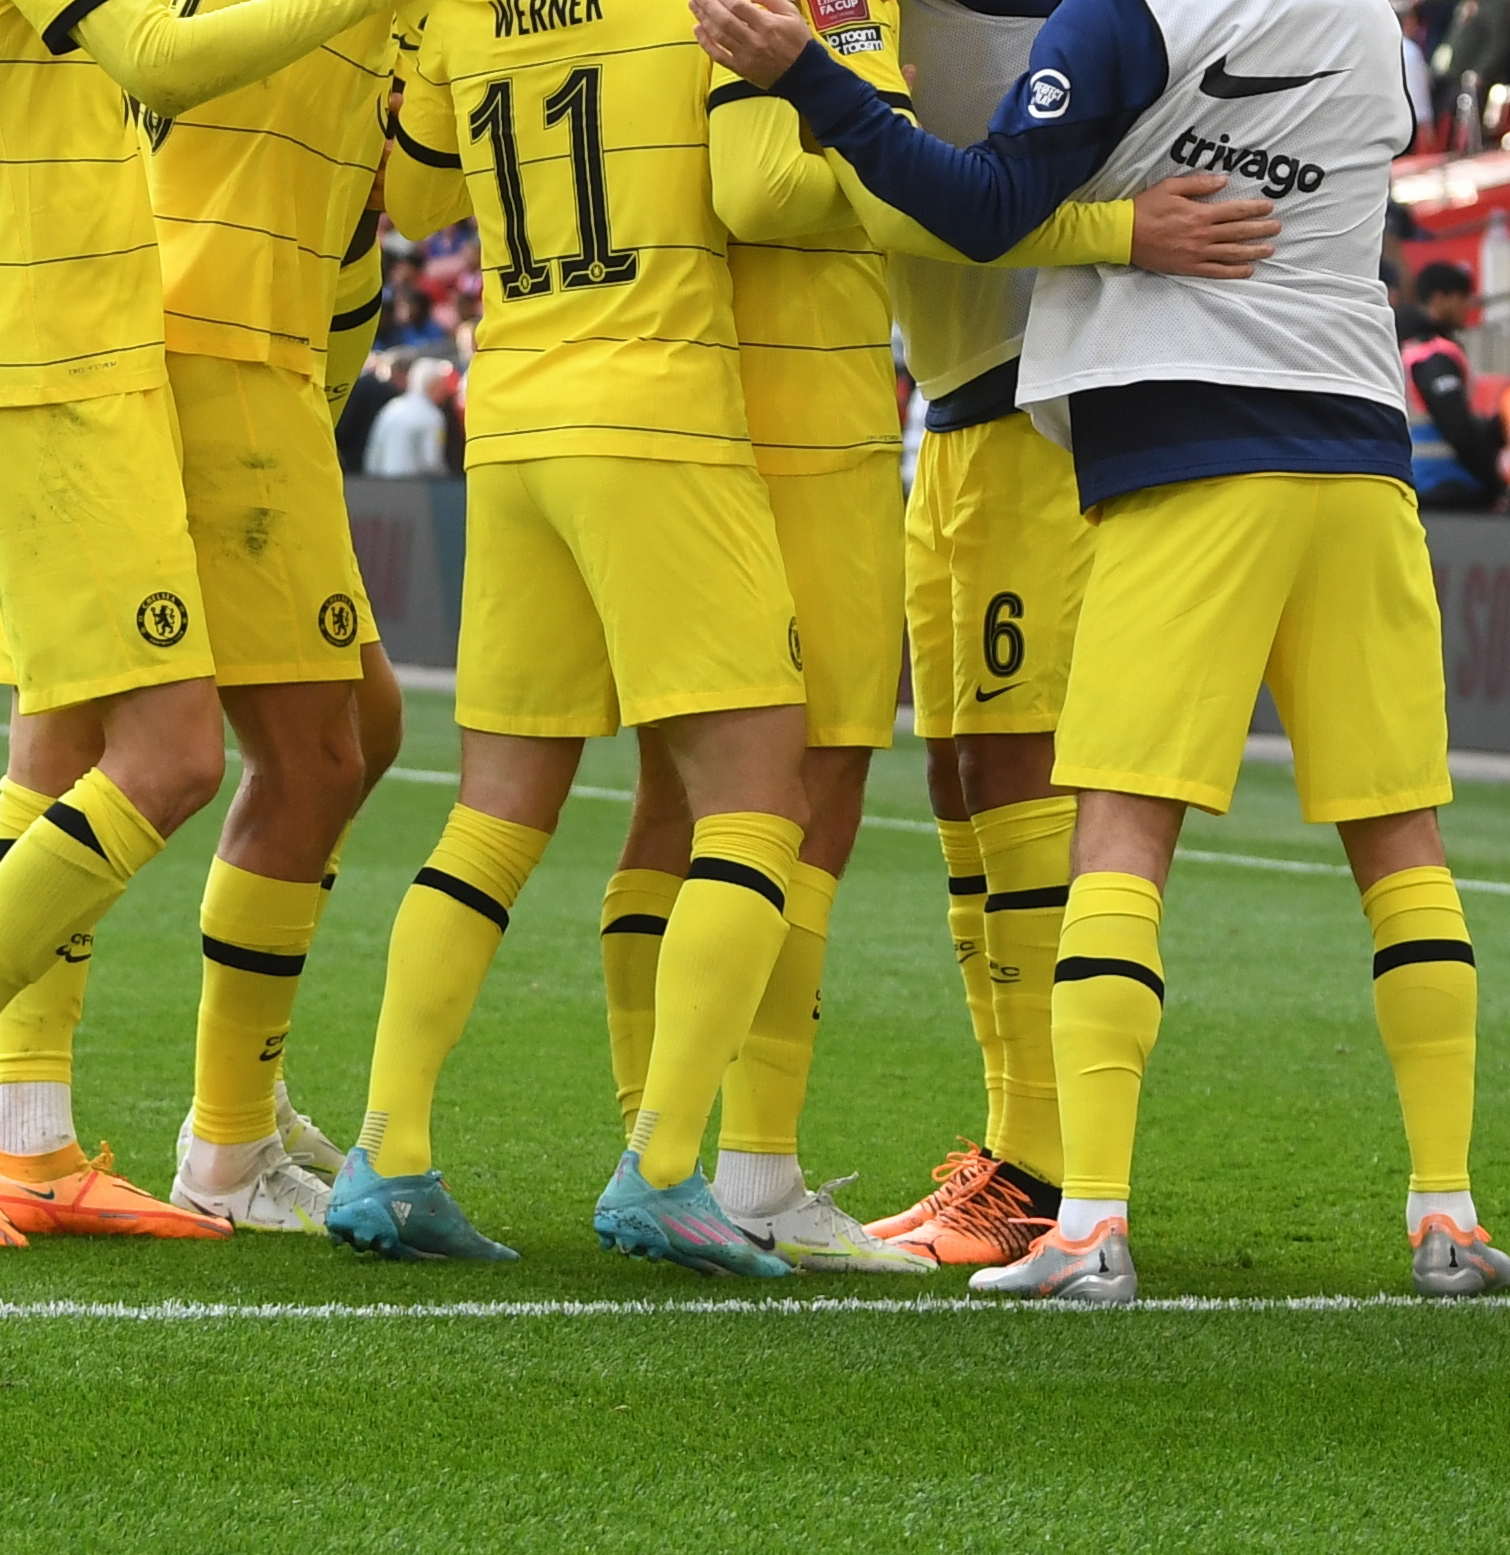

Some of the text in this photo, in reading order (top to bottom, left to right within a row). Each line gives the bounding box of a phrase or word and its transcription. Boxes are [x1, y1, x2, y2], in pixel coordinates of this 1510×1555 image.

[819, 4, 835, 16] FA
[840, 28, 877, 43] room
[469, 63, 639, 303] 11
[1170, 125, 1325, 199] trivago
[983, 590, 1025, 679] 6
